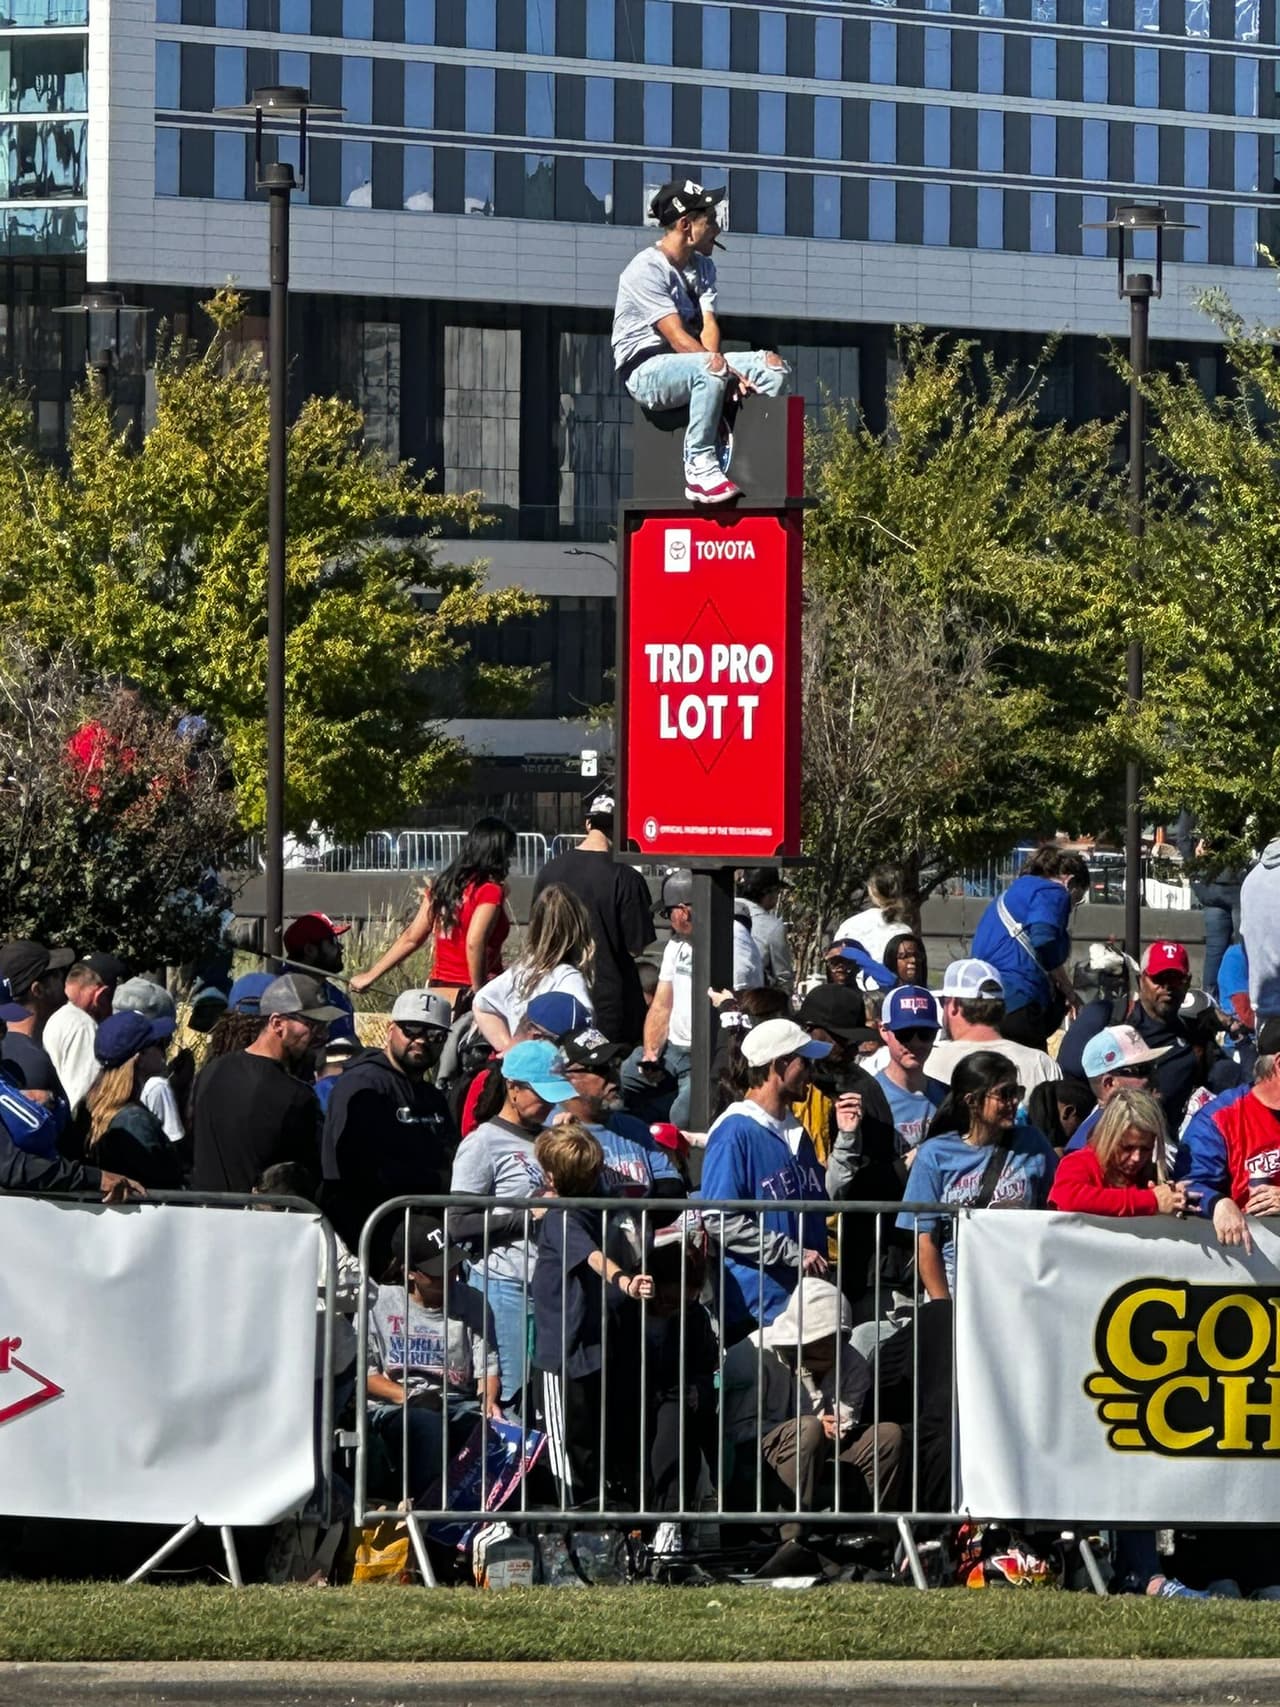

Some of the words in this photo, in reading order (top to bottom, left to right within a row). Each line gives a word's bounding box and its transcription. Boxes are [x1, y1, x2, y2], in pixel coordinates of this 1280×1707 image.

[696, 540, 756, 561] TOYOTA
[644, 643, 704, 684] TRD
[711, 643, 774, 685] PRO
[659, 694, 729, 740] LOT
[737, 694, 760, 740] T
[1162, 944, 1177, 959] T
[420, 993, 438, 1012] T
[427, 1228, 445, 1249] T
[1106, 1288, 1280, 1381] GO
